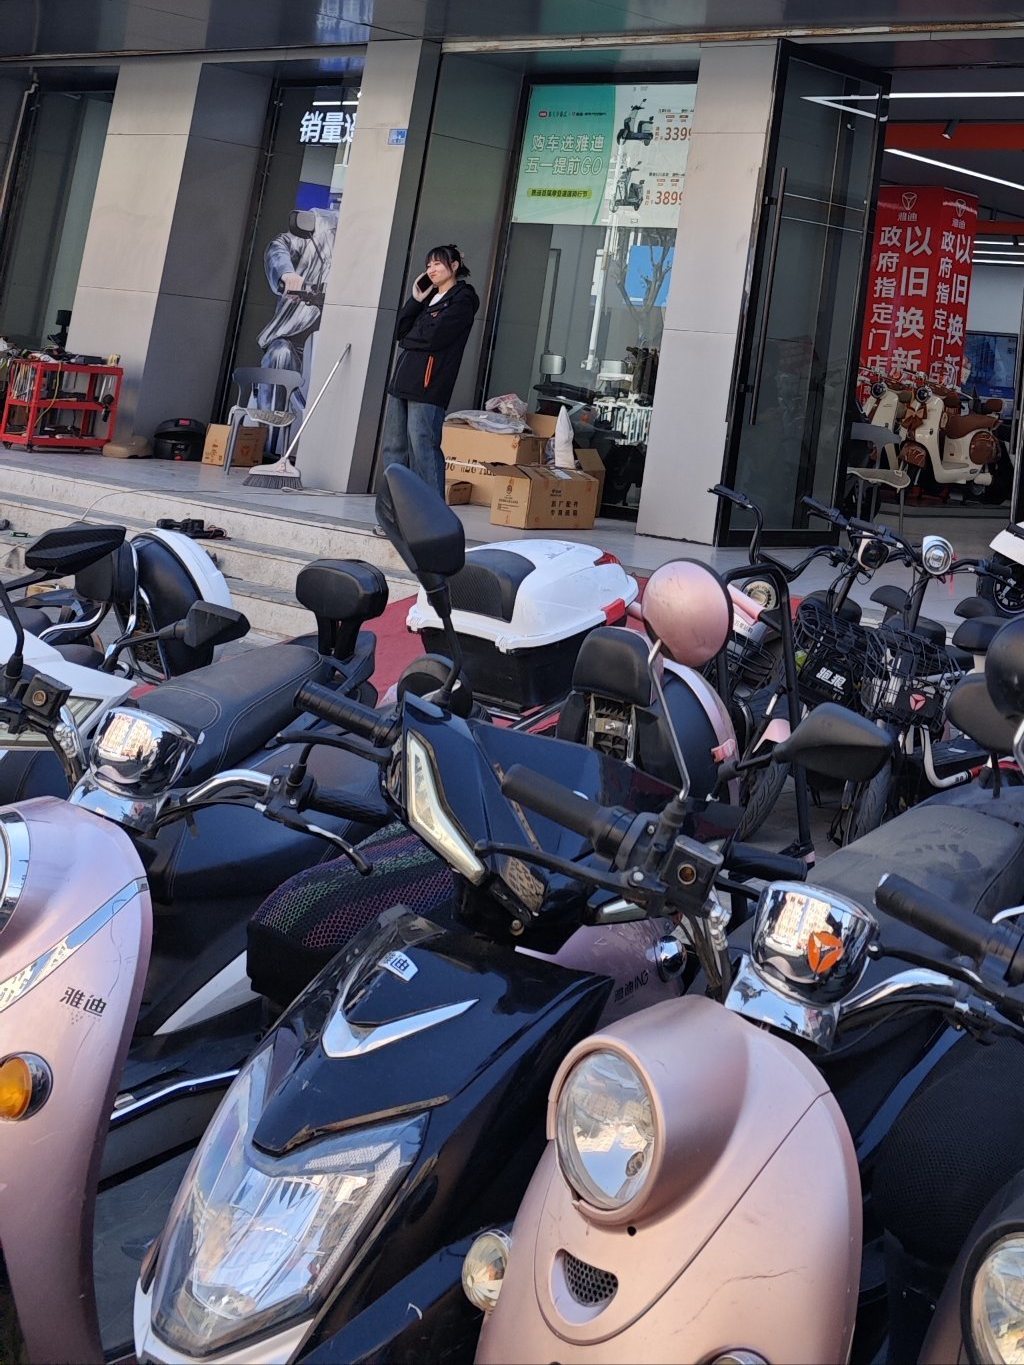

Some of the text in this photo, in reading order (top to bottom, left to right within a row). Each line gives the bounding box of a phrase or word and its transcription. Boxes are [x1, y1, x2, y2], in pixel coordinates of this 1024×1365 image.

[531, 135, 604, 152] 购车选雅迪
[525, 156, 603, 175] 五一提前GO
[897, 211, 918, 222] 雅迪
[891, 225, 933, 378] 以旧换新
[943, 232, 971, 388] 以旧换新
[60, 986, 107, 1017] 雅迪
